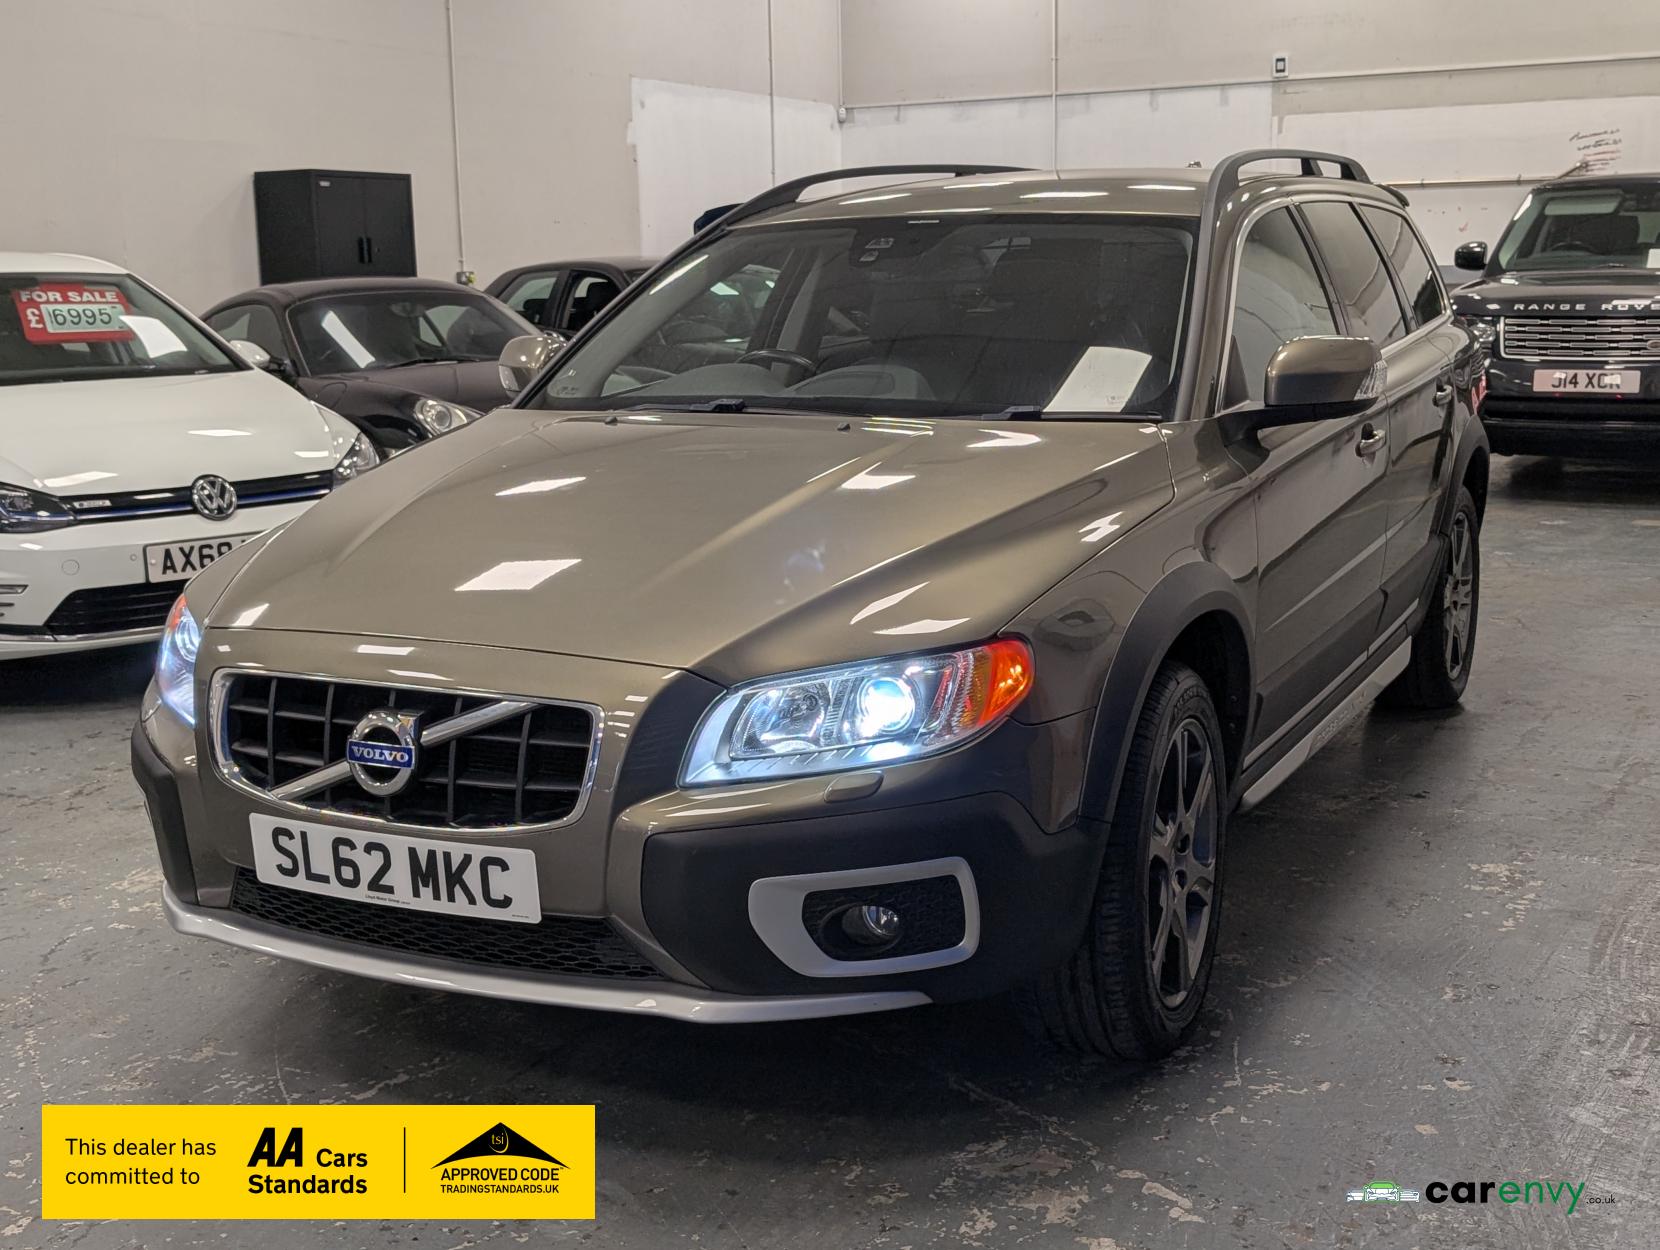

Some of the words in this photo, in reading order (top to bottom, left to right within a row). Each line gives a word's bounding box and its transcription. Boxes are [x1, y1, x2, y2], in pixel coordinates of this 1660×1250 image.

[19, 290, 64, 303] FOR
[67, 291, 119, 303] SALE
[1513, 303, 1587, 311] RANGE
[26, 307, 44, 329] £
[351, 745, 409, 763] VOLVO
[270, 826, 395, 896] SL62
[407, 845, 514, 910] MKC
